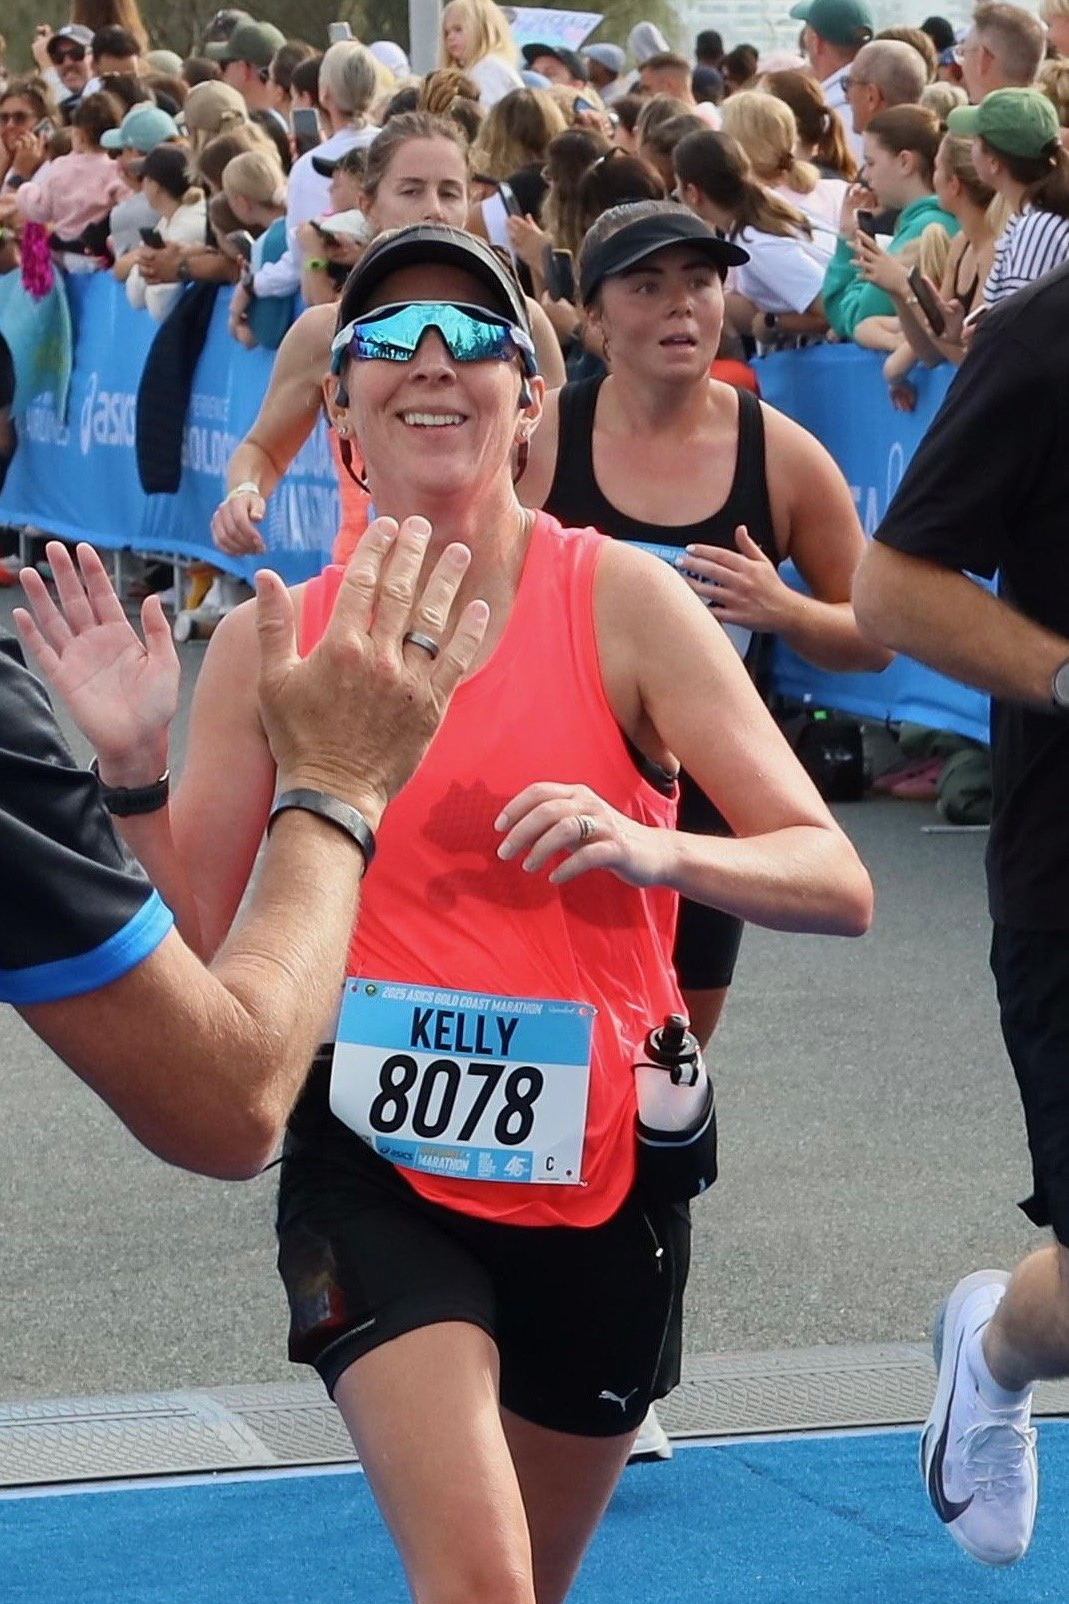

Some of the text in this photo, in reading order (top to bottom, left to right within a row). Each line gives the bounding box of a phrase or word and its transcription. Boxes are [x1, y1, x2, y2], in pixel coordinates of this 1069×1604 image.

[381, 986, 406, 1001] 2025
[406, 989, 435, 1003] ASICS
[434, 992, 459, 1008] GOLD
[459, 995, 492, 1011] COAST
[492, 998, 544, 1015] MARATHON
[410, 1006, 520, 1057] KELLY
[368, 1053, 544, 1146] 8078
[418, 1154, 470, 1173] MARATHON
[545, 1156, 555, 1172] C
